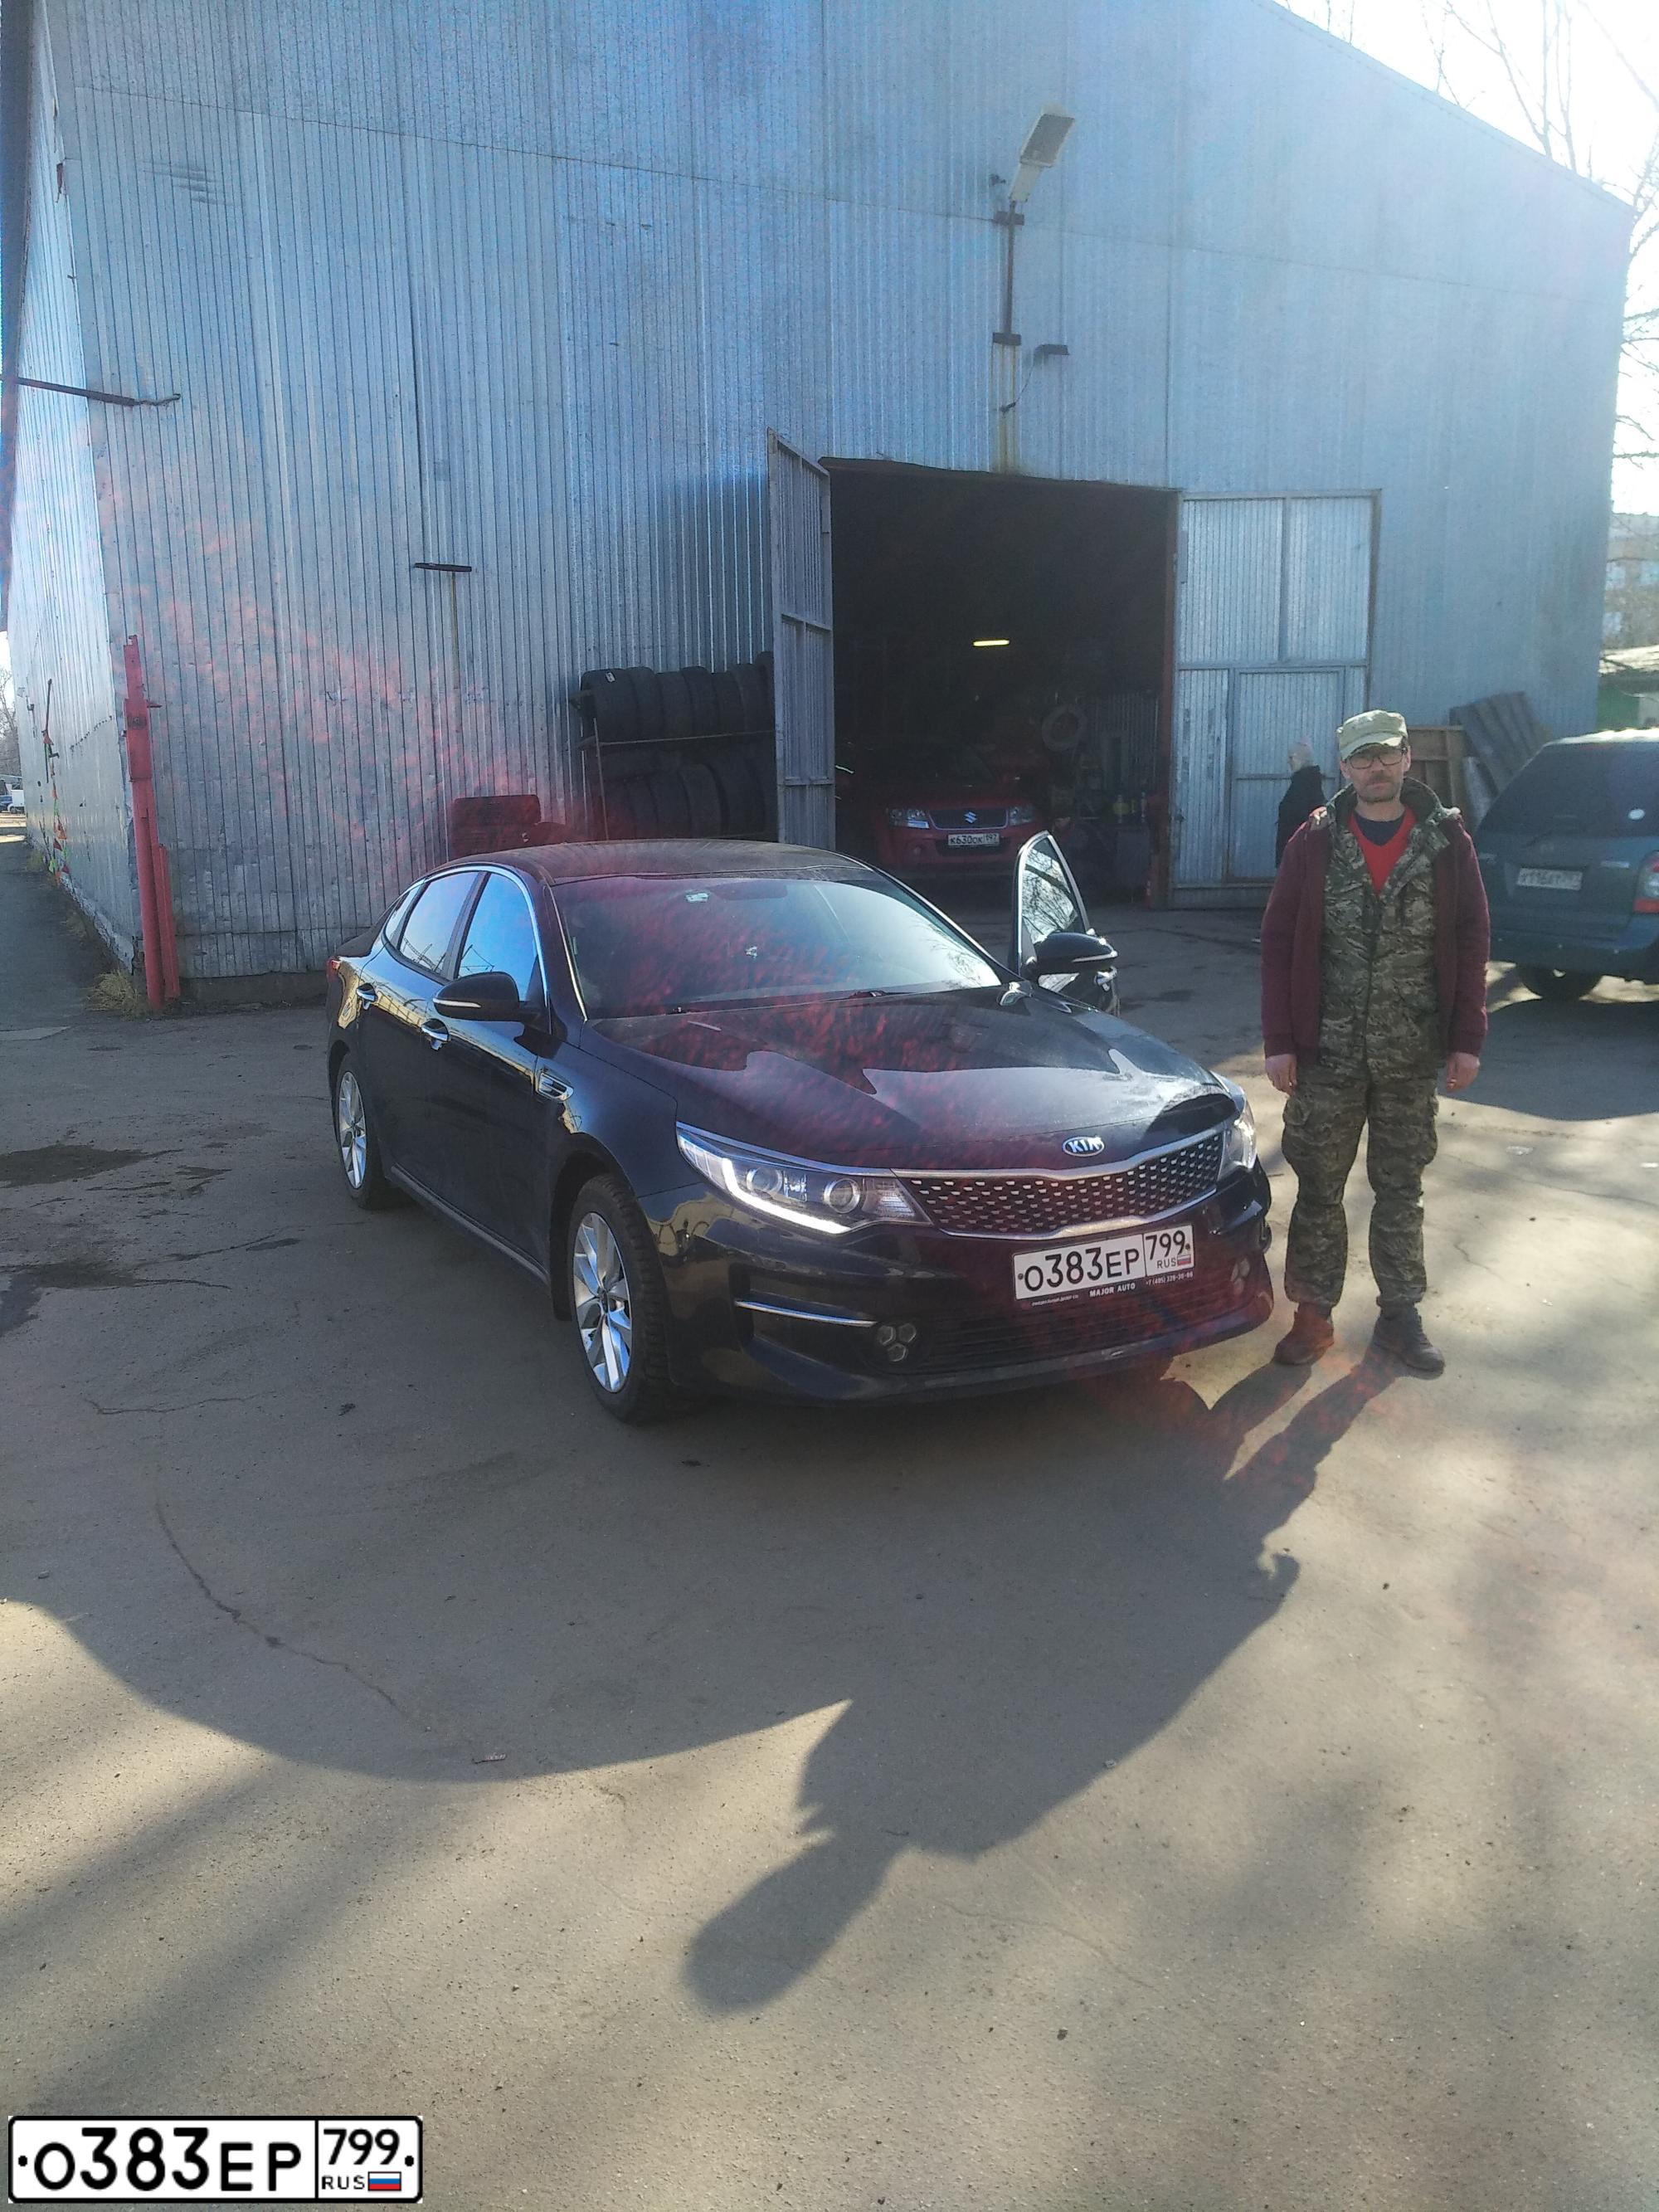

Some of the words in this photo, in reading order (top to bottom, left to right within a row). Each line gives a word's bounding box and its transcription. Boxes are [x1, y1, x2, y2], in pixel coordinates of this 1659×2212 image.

[1068, 1138, 1101, 1152] KIA
[1024, 1247, 1140, 1291] О383ЕР
[1146, 1230, 1186, 1260] 799
[1156, 1257, 1176, 1269] RUS
[1089, 1286, 1115, 1298] MAJOR
[1117, 1282, 1136, 1294] AUTO
